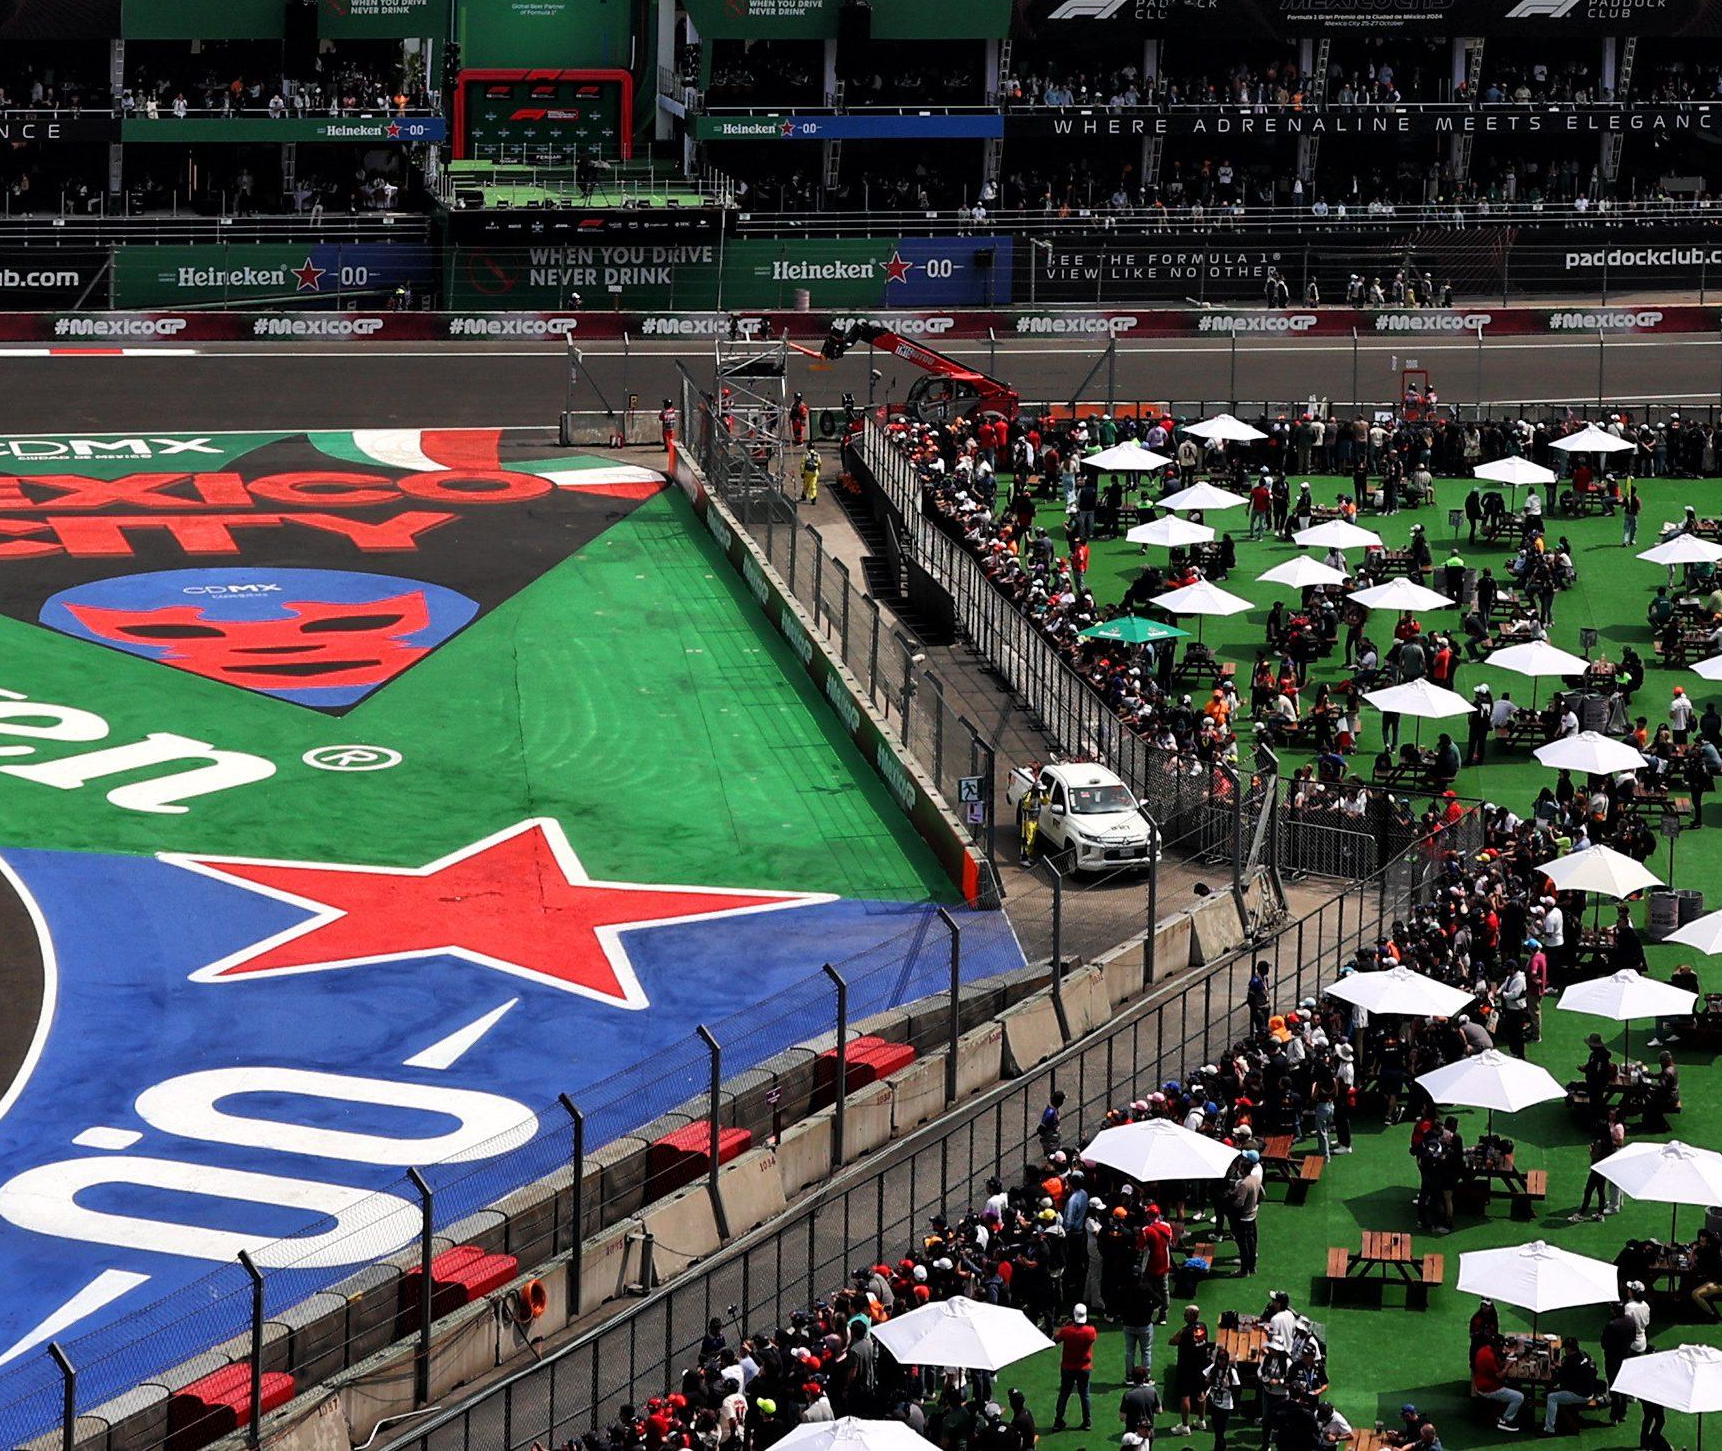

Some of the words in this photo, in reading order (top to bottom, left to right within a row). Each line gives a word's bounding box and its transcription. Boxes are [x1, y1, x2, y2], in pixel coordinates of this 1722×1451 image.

[749, 0, 775, 8] WHEN
[778, 0, 795, 8] YOU
[1587, 9, 1631, 18] CLUB
[1054, 119, 1167, 133] WHERE
[1193, 117, 1409, 132] ADRENALINE
[1436, 116, 1541, 131] MEETS
[530, 246, 594, 266] WHEN
[601, 246, 645, 265] YOU
[653, 245, 713, 264] DRIVE
[1149, 253, 1248, 264] FORMULA
[341, 267, 368, 285] 0.0
[530, 268, 597, 286] NEVER
[605, 267, 672, 286] DRINK
[927, 259, 952, 278] 0.0
[1047, 268, 1099, 279] VIEW
[1112, 268, 1157, 279] LIKE
[1171, 267, 1197, 278] NO
[1210, 266, 1276, 278] OTHER
[54, 317, 187, 336] #MexicoGP
[253, 317, 384, 336] #MexicoGP
[449, 318, 577, 336] #MexicoGP
[1016, 315, 1138, 334] #MexicoGP
[1197, 315, 1318, 332] #MexicoGP
[1375, 313, 1492, 331] #MexicoGP
[1549, 311, 1663, 329] #MexicoGP
[183, 583, 282, 595] CDMX
[759, 1156, 776, 1172] 1034
